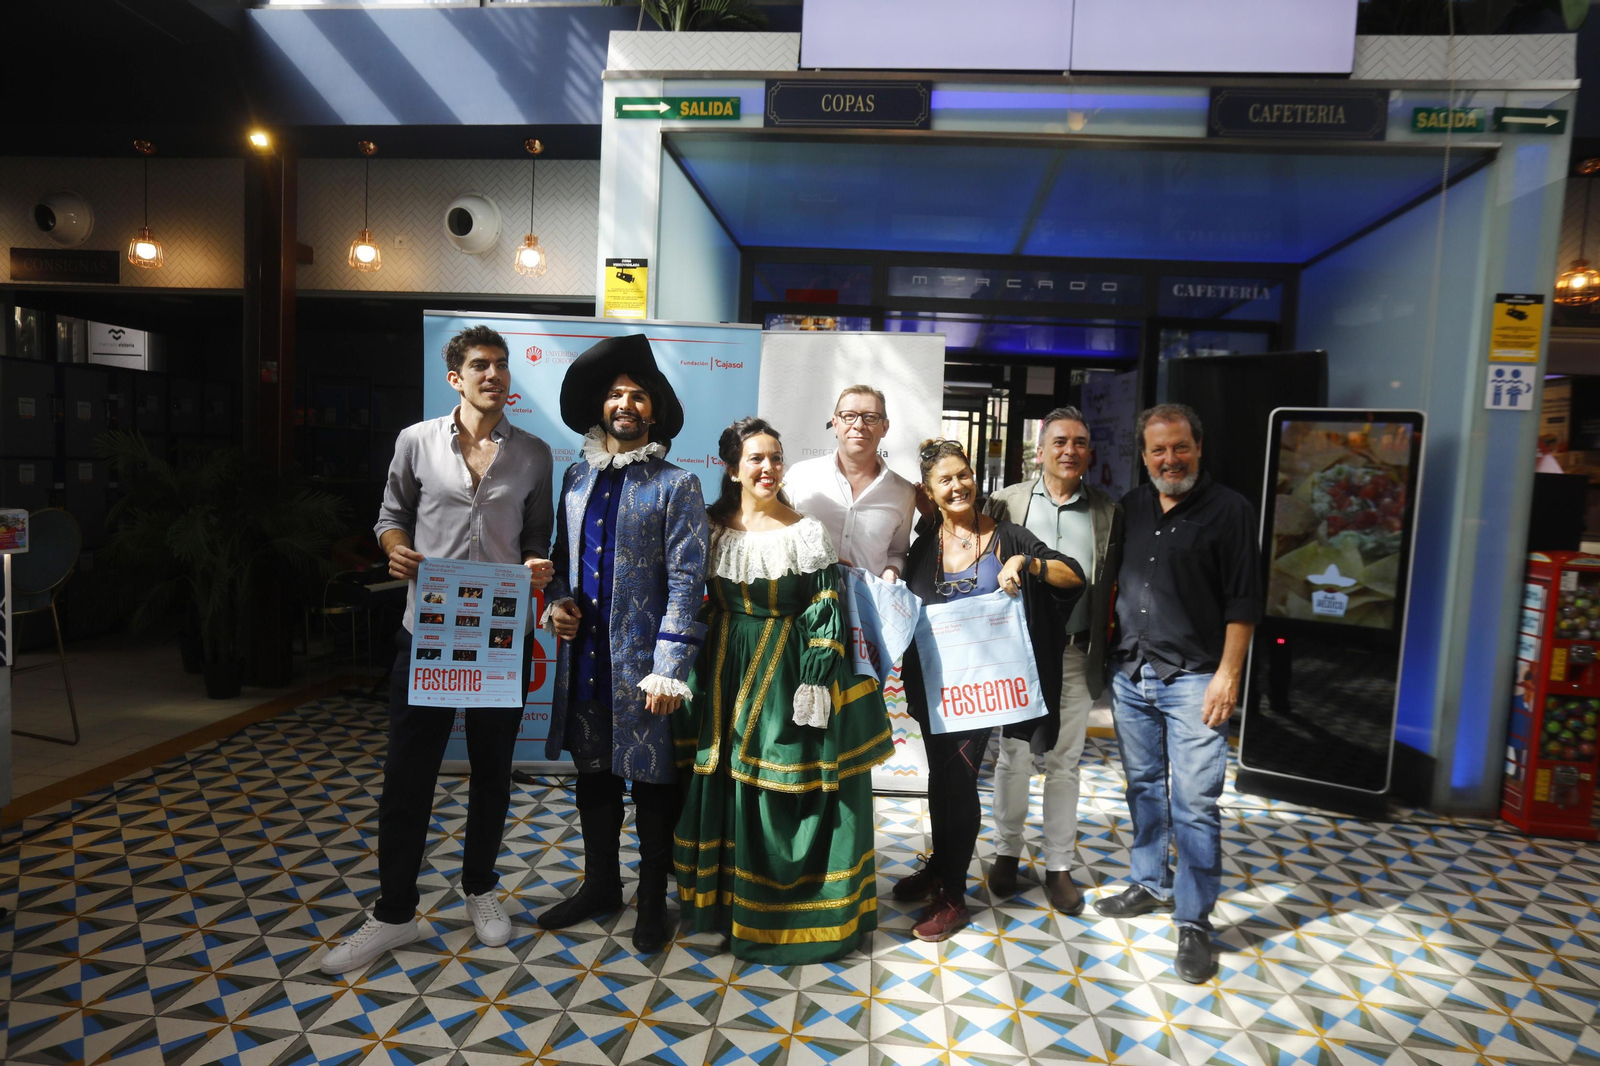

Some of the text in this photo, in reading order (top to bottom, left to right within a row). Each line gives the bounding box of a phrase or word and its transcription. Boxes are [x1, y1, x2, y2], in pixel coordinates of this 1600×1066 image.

[680, 101, 733, 116] SALIDA
[821, 94, 875, 112] COPAS
[1249, 103, 1347, 124] CAFETERIA
[1416, 111, 1477, 128] SALIDA
[23, 258, 107, 273] CONSIGNAS
[545, 350, 579, 358] UNIVERSIDAD
[715, 359, 744, 370] Cajasol
[552, 448, 576, 456] VERSIDAD
[801, 447, 834, 457] merca
[414, 667, 482, 692] Festeme
[940, 677, 1029, 717] Festeme
